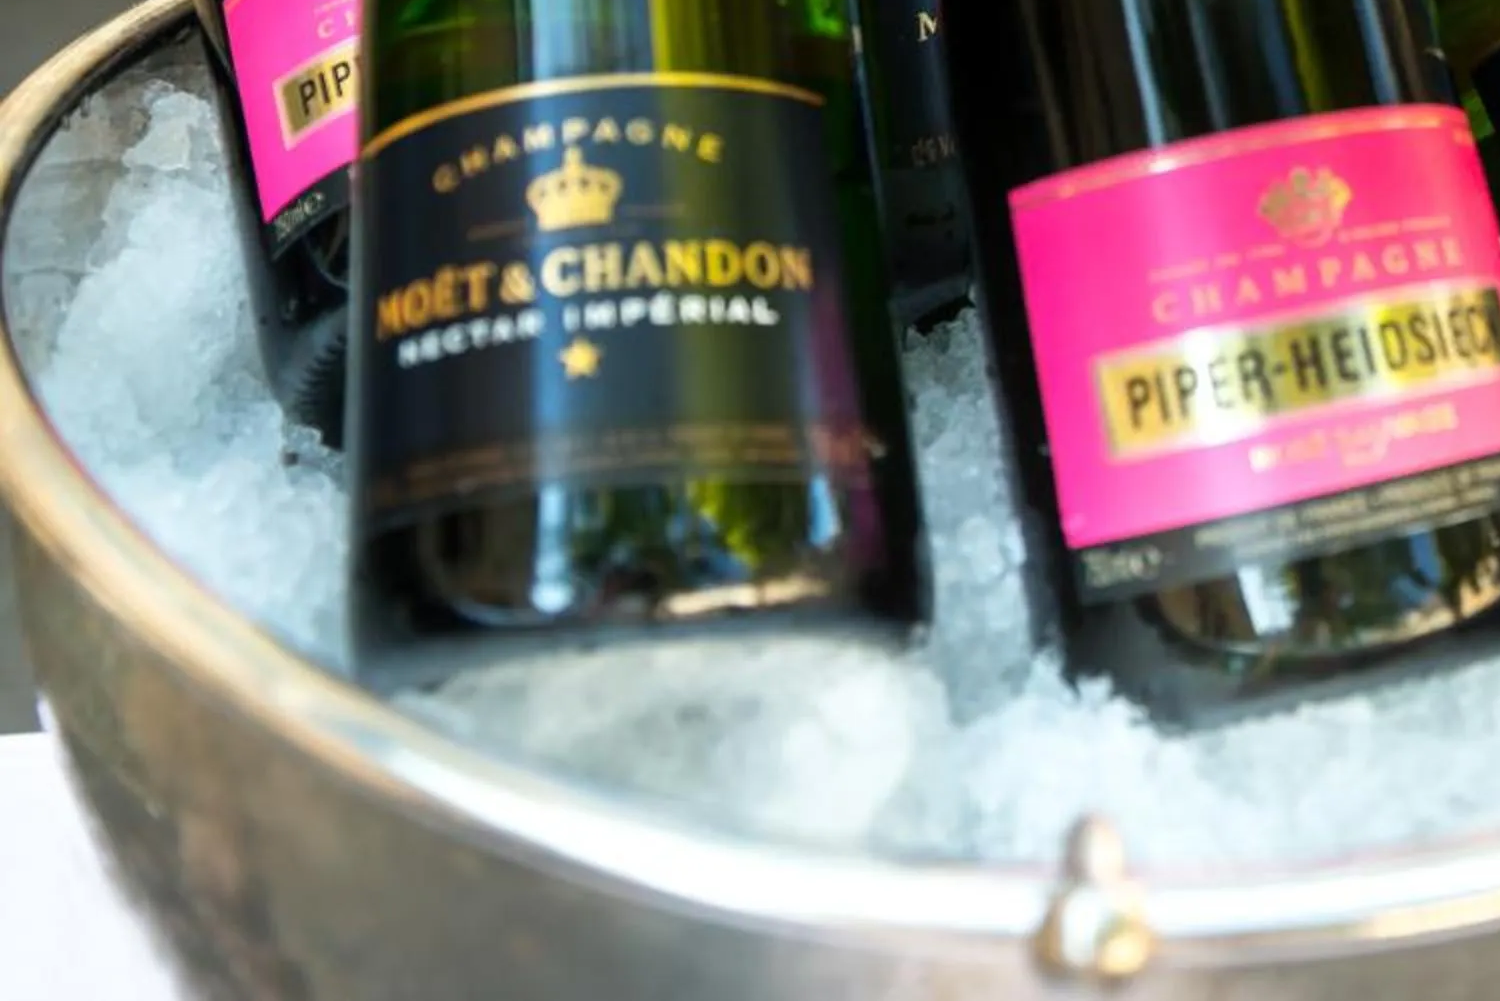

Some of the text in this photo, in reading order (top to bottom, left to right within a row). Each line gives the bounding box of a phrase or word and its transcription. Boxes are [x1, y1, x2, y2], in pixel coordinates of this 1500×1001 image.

[432, 116, 724, 194] CHAMPAGNE
[376, 238, 815, 340] MOËT & CHANDON
[1151, 236, 1464, 325] CHAMPAGNE
[398, 307, 546, 368] NECTAR
